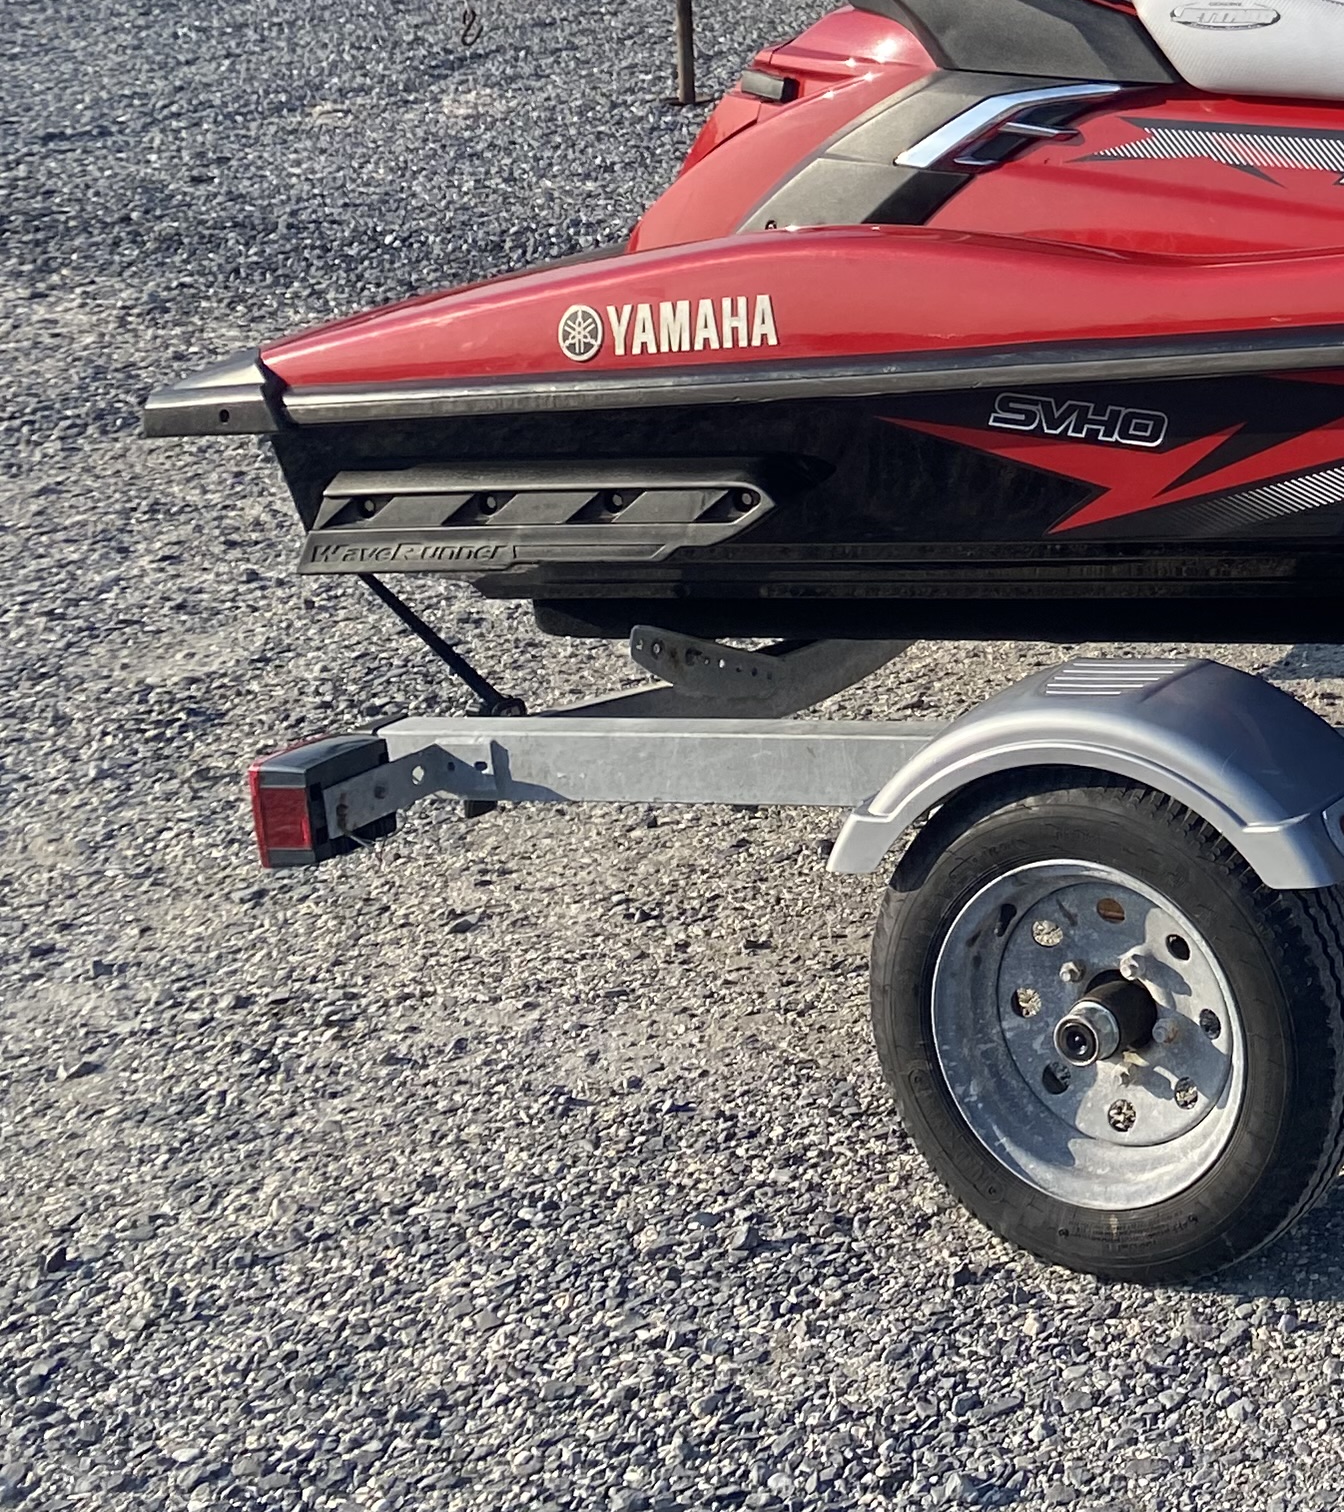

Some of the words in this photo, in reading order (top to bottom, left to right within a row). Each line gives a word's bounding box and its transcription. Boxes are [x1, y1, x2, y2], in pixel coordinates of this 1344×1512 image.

[606, 295, 778, 356] YAMAHA
[988, 392, 1168, 448] SVHO
[311, 542, 507, 564] WaveRunner
